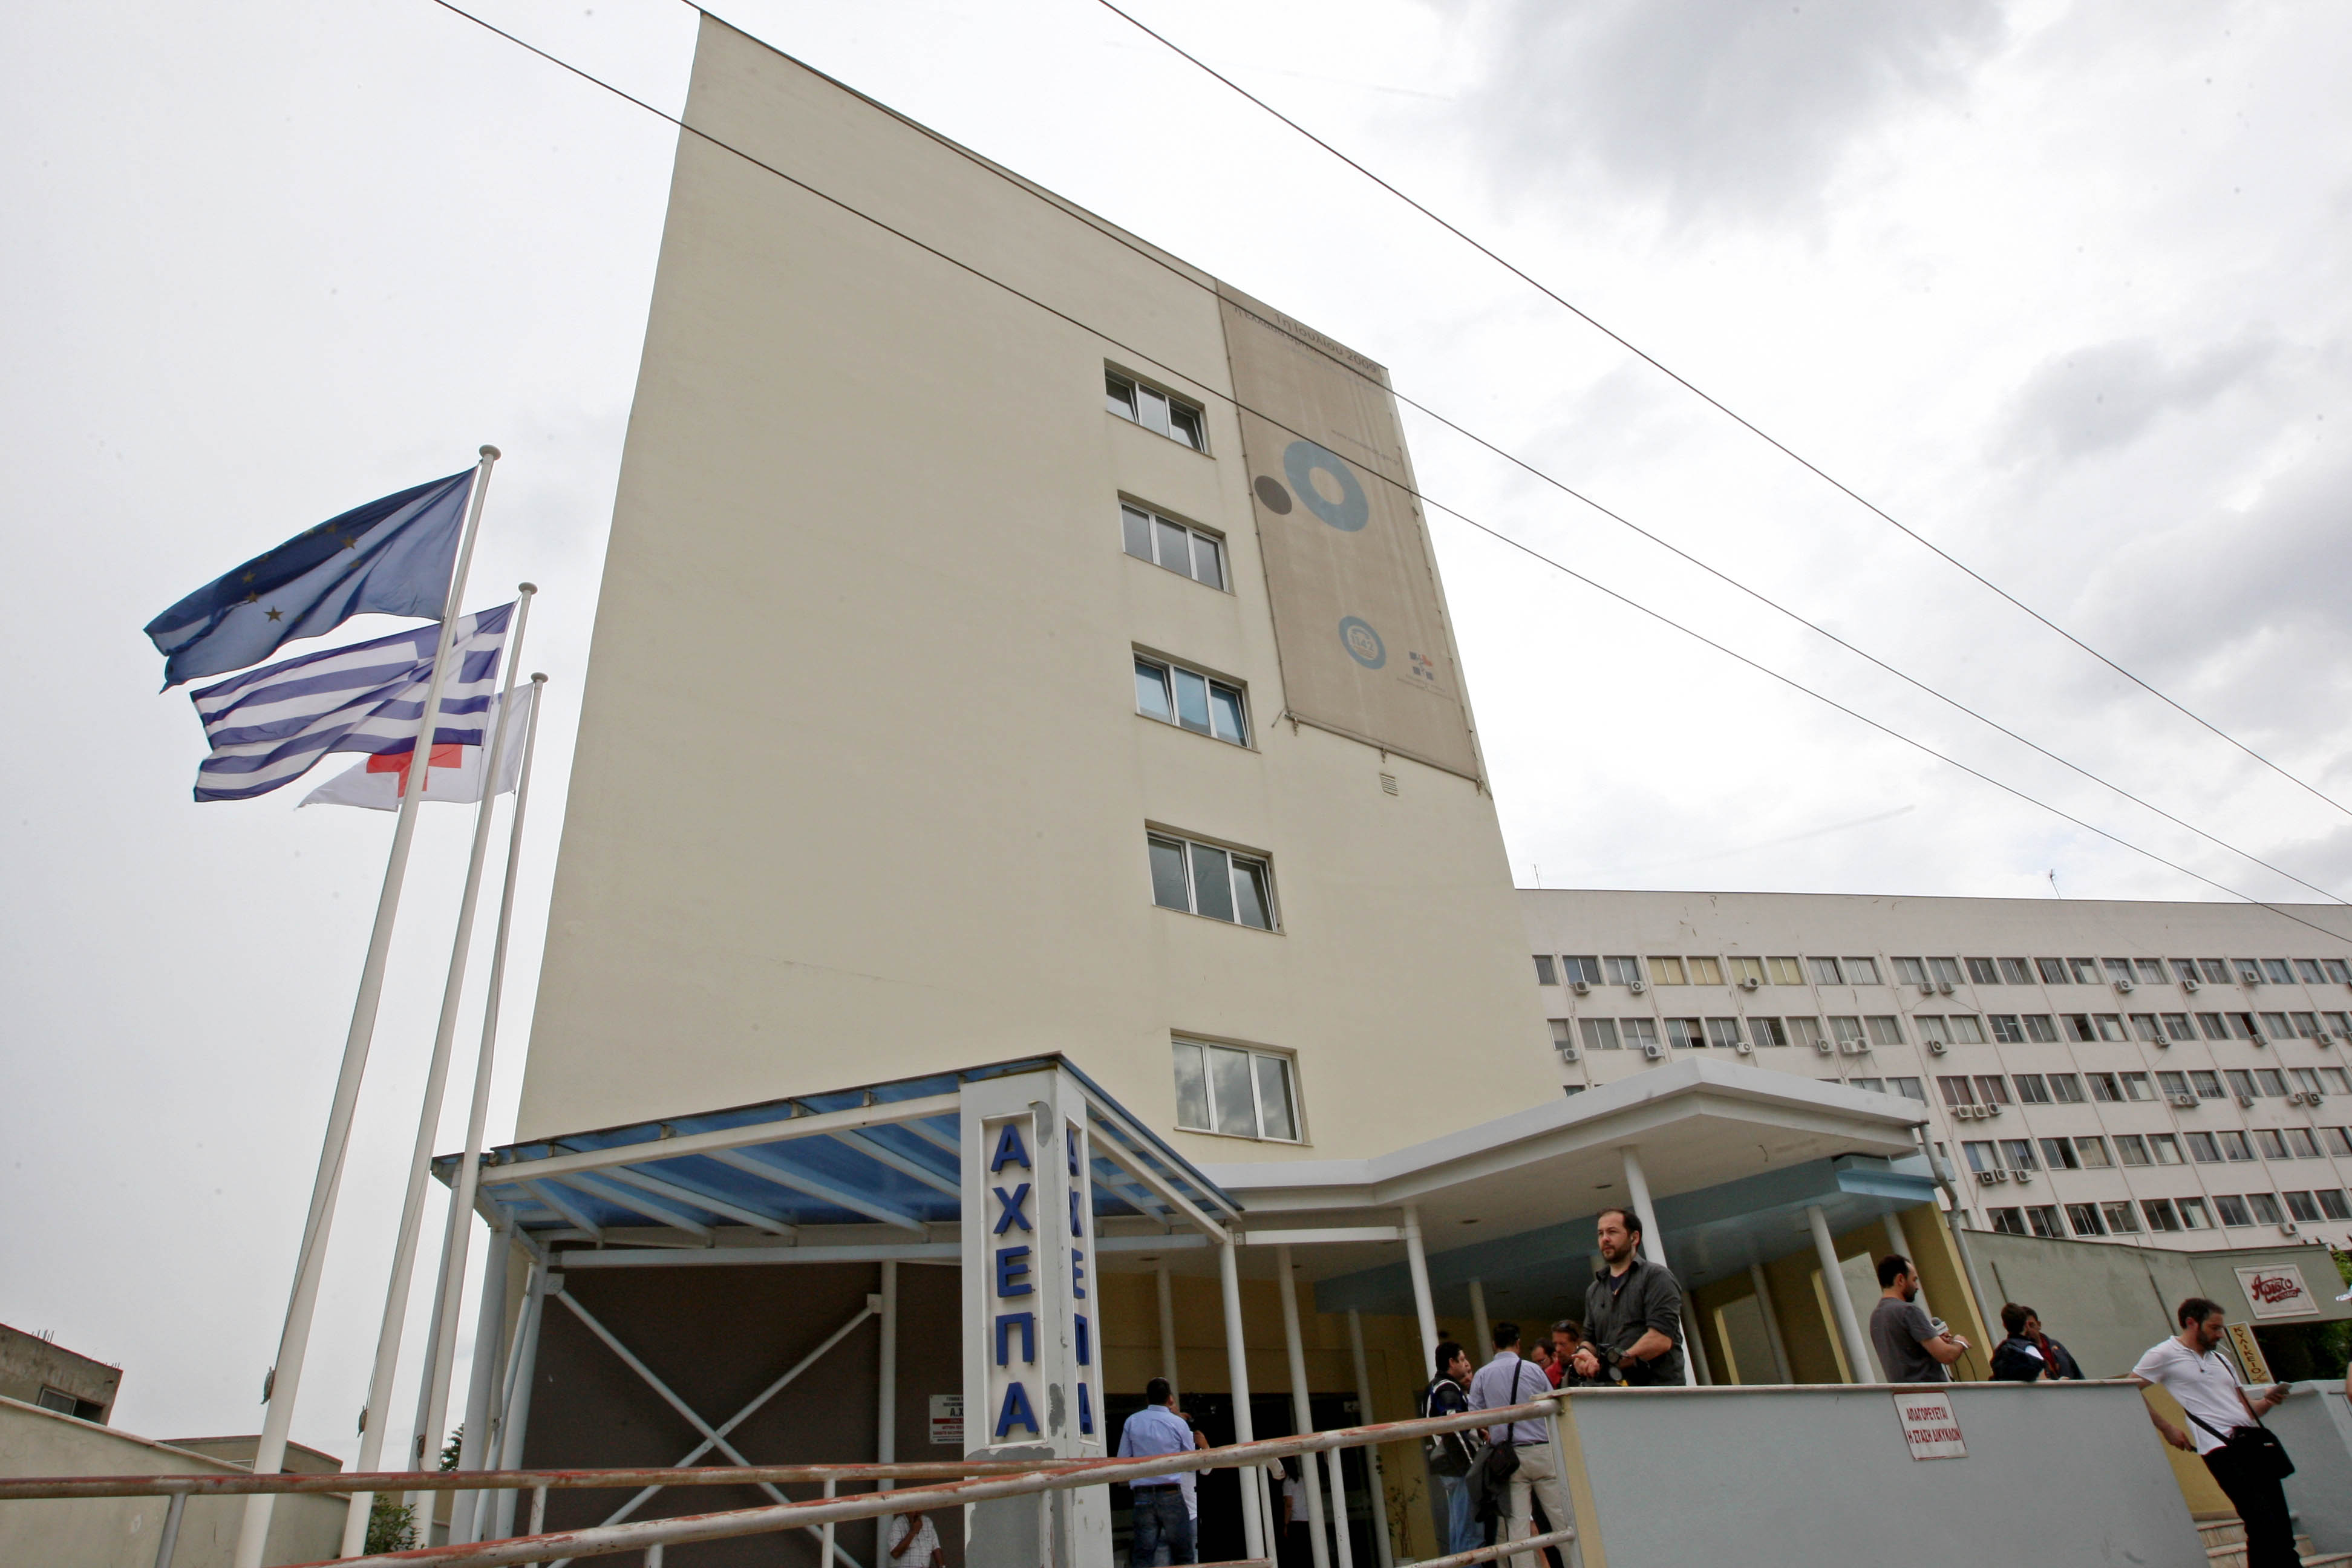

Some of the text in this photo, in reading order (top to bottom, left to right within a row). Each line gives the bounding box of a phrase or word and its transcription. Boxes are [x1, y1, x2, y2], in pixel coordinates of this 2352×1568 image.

[1345, 350, 1377, 373] 2009
[991, 1124, 1039, 1437] ΑΧΕΠΑ
[1067, 1128, 1094, 1434] ΑΧΕΠΑ
[1906, 1406, 1949, 1422] ΑΠΑΓΟΡΕΥΕΤΑΙ
[1907, 1430, 1914, 1444] Η
[1912, 1429, 1933, 1443] ΣΤΑΣΗ
